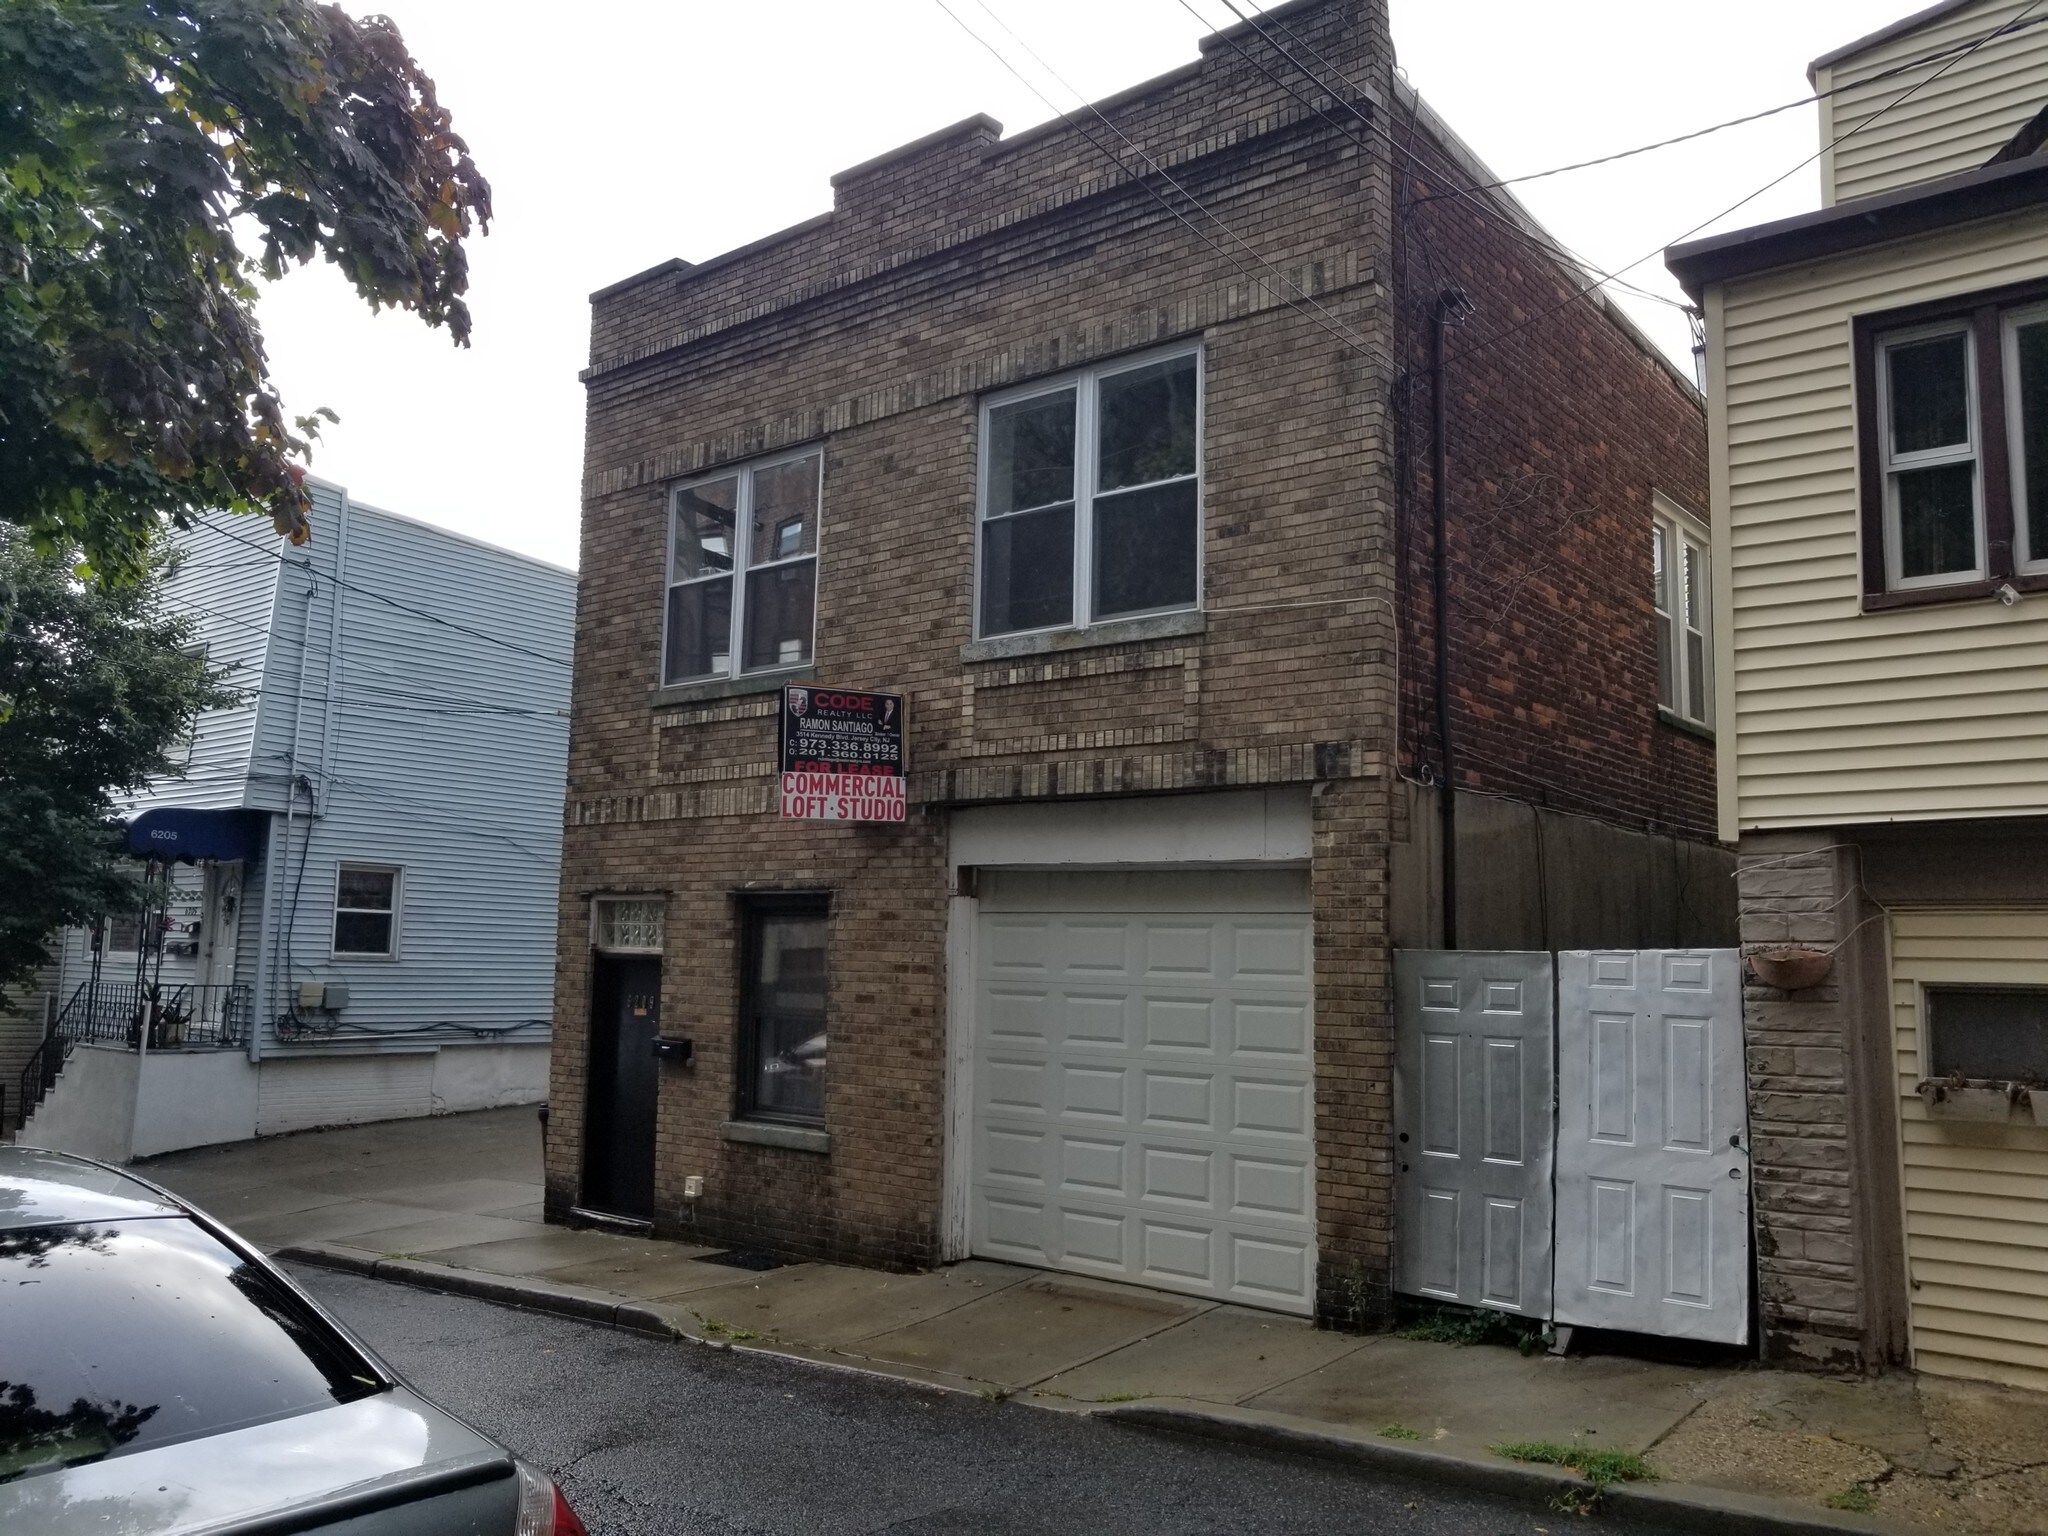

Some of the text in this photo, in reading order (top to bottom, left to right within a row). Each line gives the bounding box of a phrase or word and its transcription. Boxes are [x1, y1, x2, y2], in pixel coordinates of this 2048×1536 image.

[814, 693, 874, 711] CODE
[818, 709, 853, 718] REALTY
[800, 718, 874, 734] RAMON SANTIAGO
[810, 732, 834, 740] Kennedy
[851, 734, 870, 742] Jersey
[789, 738, 898, 753] C: 973.336.8992
[798, 748, 898, 760] 201.360.0125
[794, 760, 832, 773] FOR
[837, 763, 895, 776] LEASE
[782, 772, 904, 798] COMMERCIAL
[782, 796, 905, 821] LOFT STUDIO
[150, 830, 178, 840] 6205
